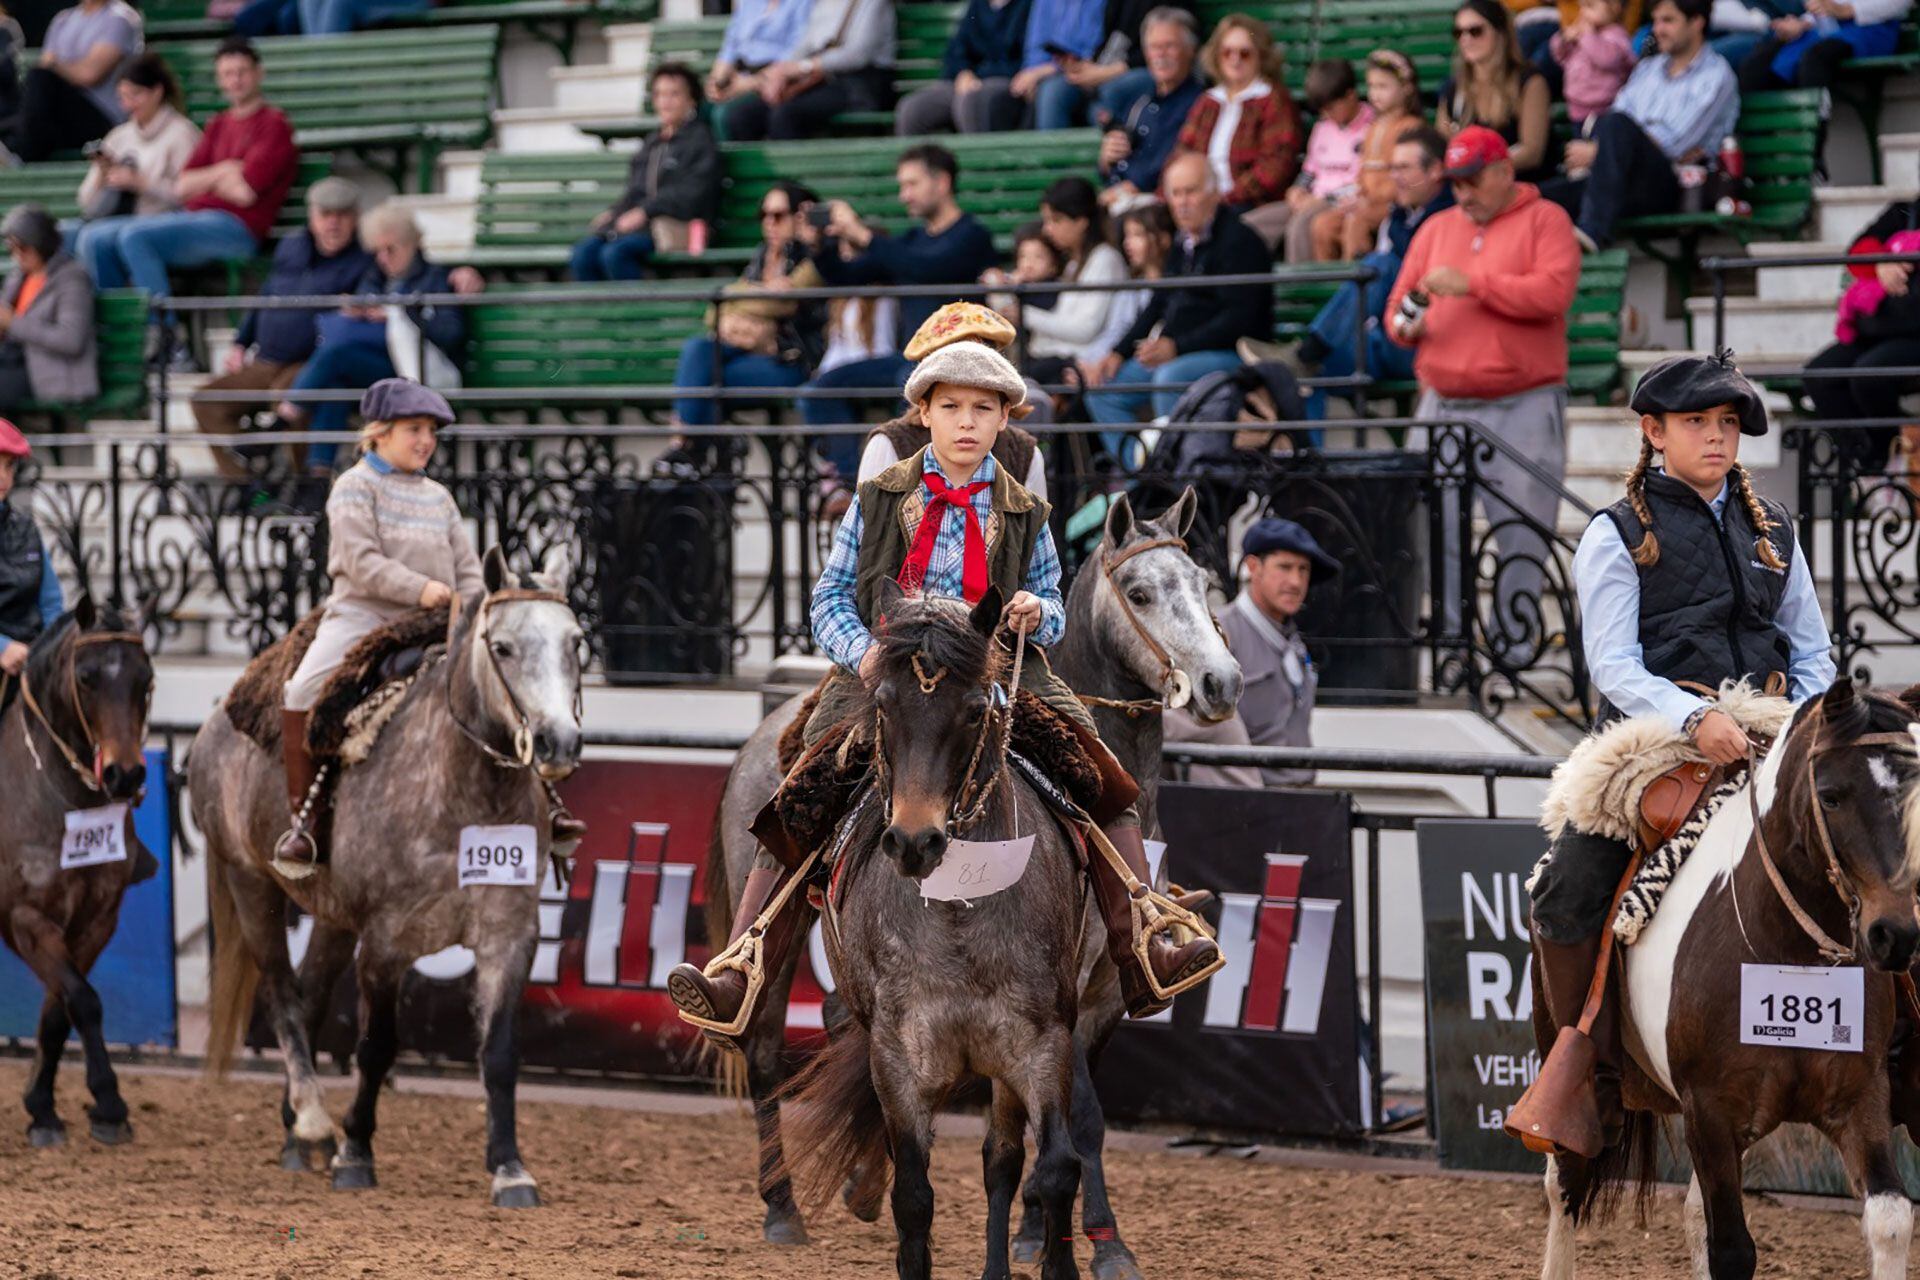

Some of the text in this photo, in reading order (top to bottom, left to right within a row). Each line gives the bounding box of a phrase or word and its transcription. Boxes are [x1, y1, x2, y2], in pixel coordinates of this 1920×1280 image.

[75, 823, 114, 848] 1907
[466, 845, 523, 868] 1909
[959, 862, 991, 885] 81
[1760, 994, 1842, 1025] 1881
[1766, 1027, 1794, 1036] Galicia
[1477, 1103, 1503, 1129] La
